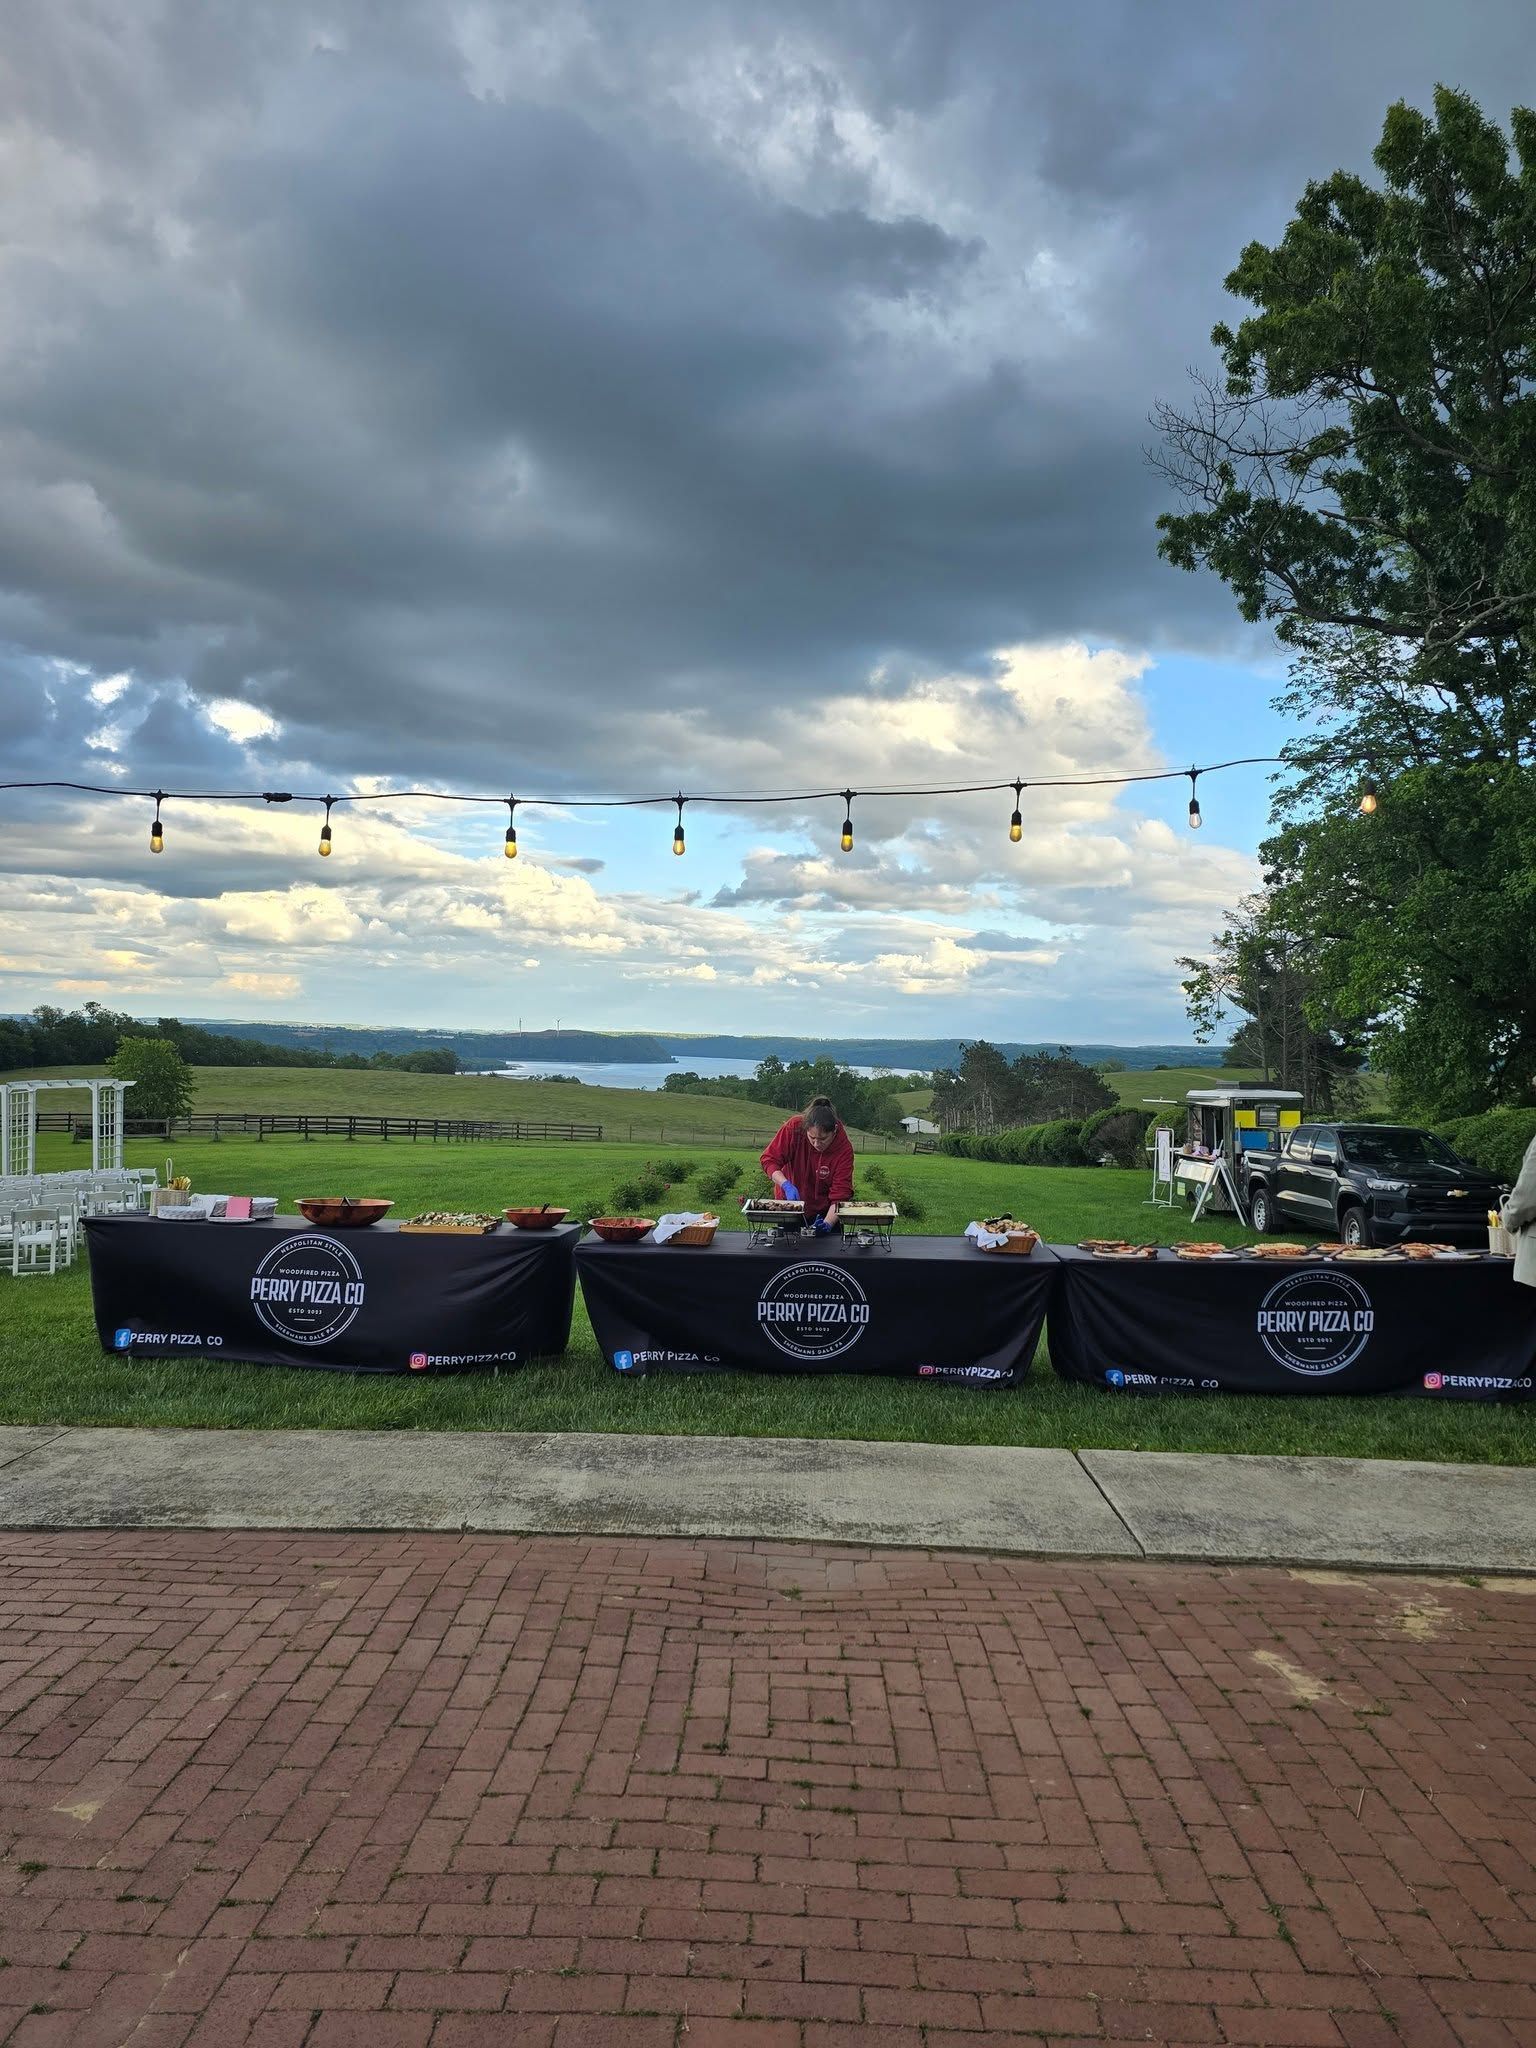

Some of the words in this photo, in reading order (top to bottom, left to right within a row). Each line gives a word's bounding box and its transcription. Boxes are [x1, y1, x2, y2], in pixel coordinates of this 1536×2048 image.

[280, 1240, 323, 1255] NEAPOLITAN
[324, 1242, 343, 1257] STYLE
[783, 1267, 825, 1280] NEAPOLITAN
[827, 1269, 846, 1282] STYLE
[1285, 1274, 1329, 1288] NEAPOLITAN
[250, 1278, 300, 1302] PERRY
[300, 1280, 341, 1304] PIZZA
[344, 1282, 365, 1305] CO
[757, 1302, 805, 1322] PERRY
[807, 1303, 847, 1322] PIZZA
[850, 1304, 870, 1323] CO
[1257, 1311, 1306, 1332] PERRY
[1309, 1311, 1350, 1332] PIZZA
[1354, 1310, 1374, 1332] CO
[130, 1333, 168, 1344] PERRY
[170, 1334, 202, 1345] PIZZA
[207, 1336, 223, 1346] CO
[275, 1323, 307, 1341] SHERMANS
[309, 1332, 325, 1341] DALE
[326, 1326, 335, 1334] PA
[783, 1340, 815, 1355] SHERMANS
[817, 1347, 834, 1355] DALE
[427, 1351, 516, 1366] PERRYPIZZACO
[632, 1350, 665, 1363] PERRY
[667, 1351, 699, 1361] PIZZA
[1321, 1360, 1338, 1370] DALE
[1124, 1374, 1158, 1384] PERRY
[1161, 1376, 1195, 1387] PIZZA
[1201, 1379, 1219, 1388] CO
[1442, 1375, 1532, 1388] PERRYPIZZACO
